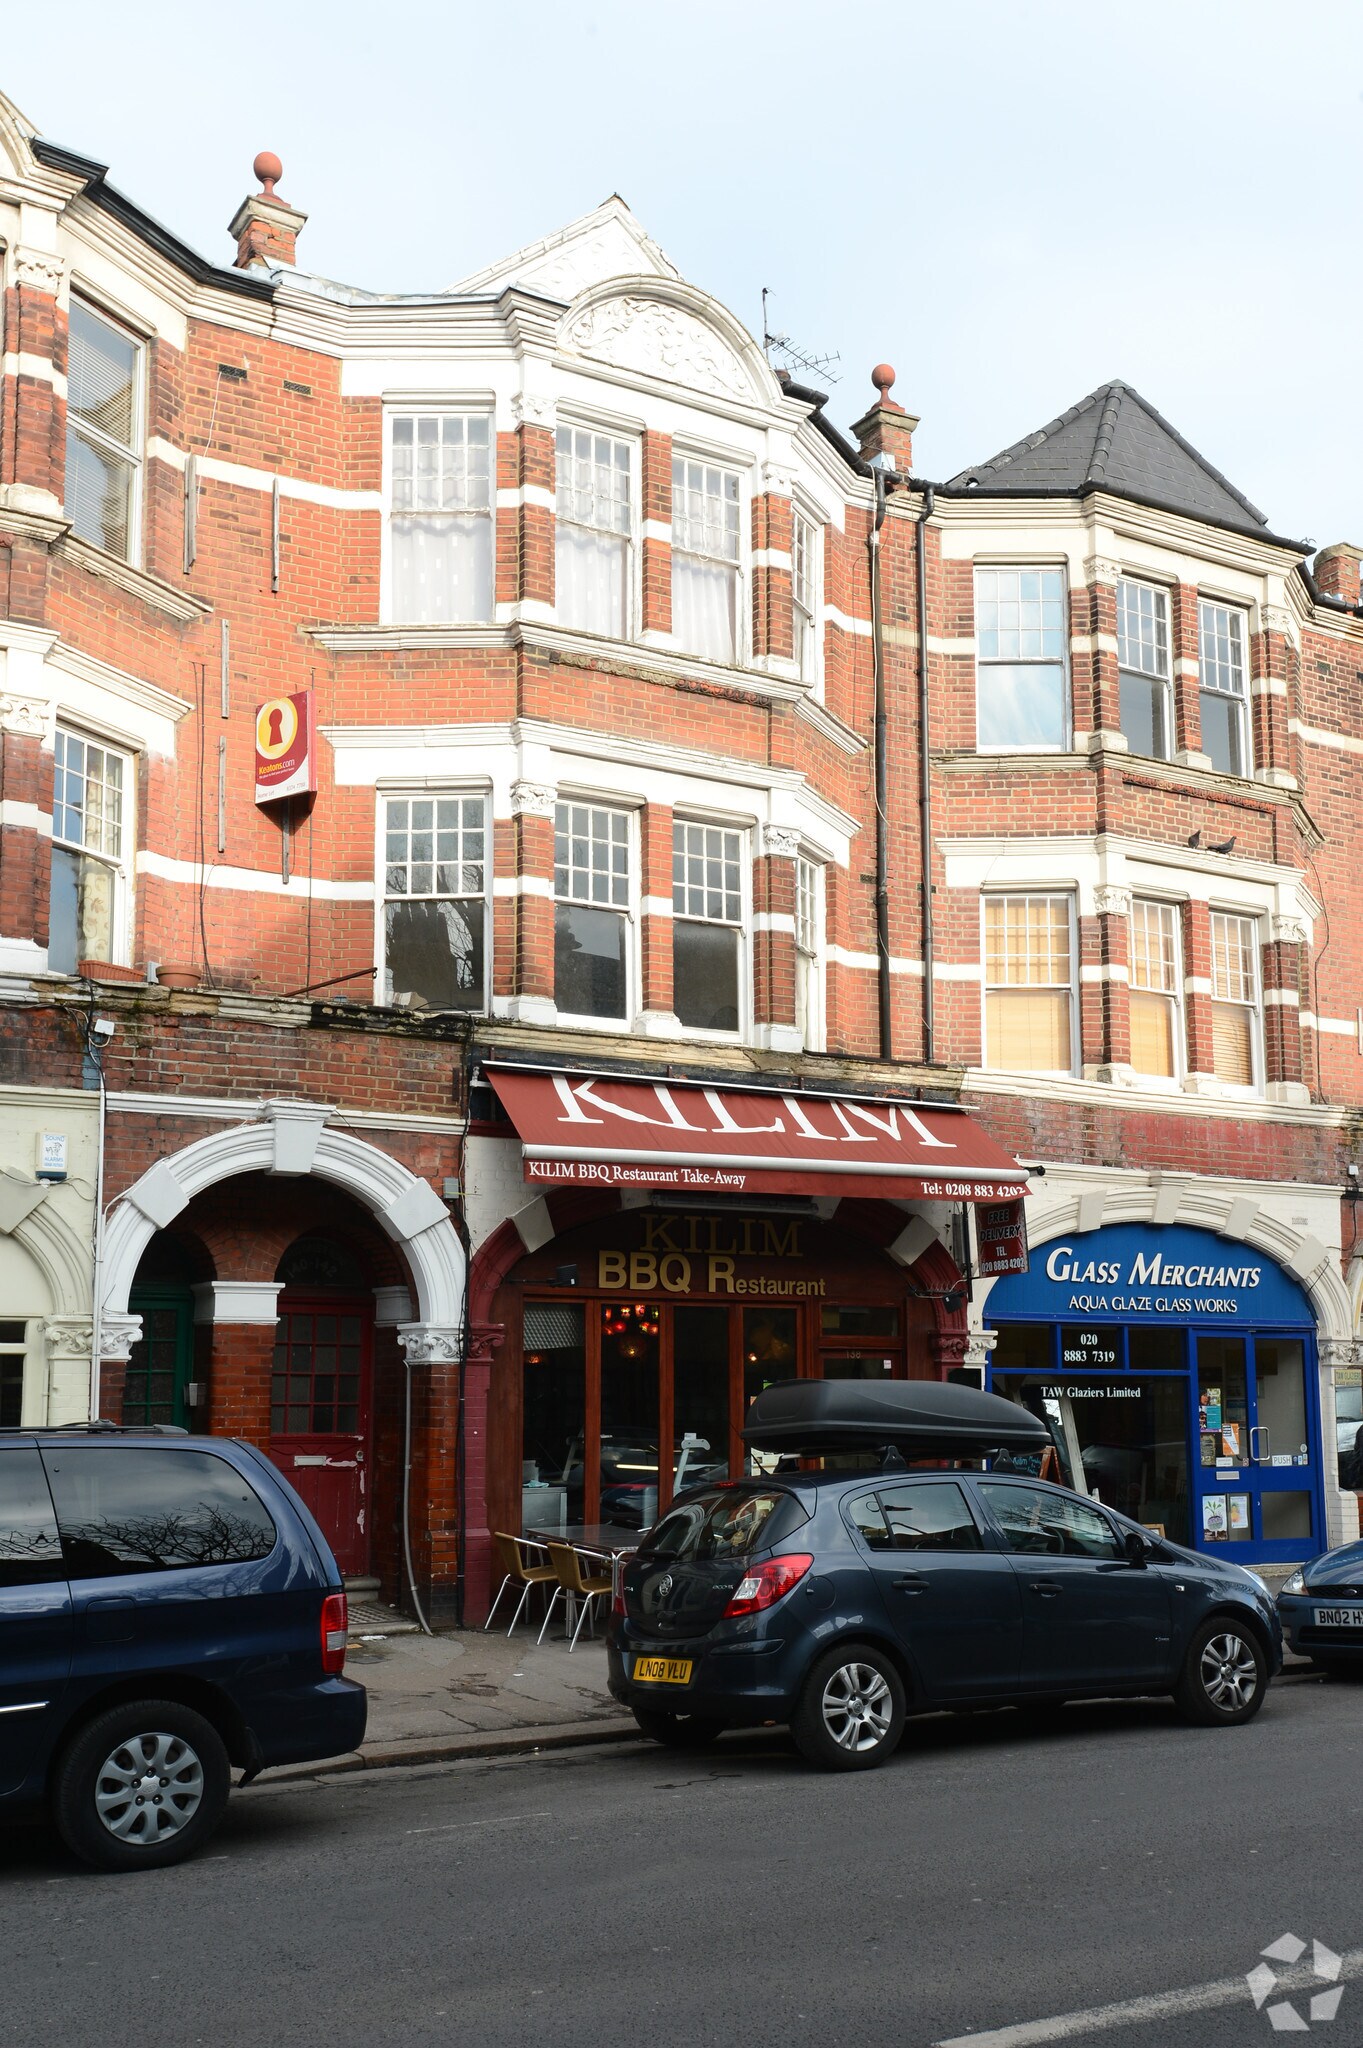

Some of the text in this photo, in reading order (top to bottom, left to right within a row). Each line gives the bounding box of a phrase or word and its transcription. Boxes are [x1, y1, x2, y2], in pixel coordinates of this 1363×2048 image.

[551, 1073, 957, 1147] KILIM
[528, 1161, 746, 1188] KILIM BBQ Restaurant Take-Away
[921, 1181, 1025, 1198] Tel: 0208 883 4202
[988, 1208, 1009, 1225] FREE
[639, 1213, 804, 1257] KILIM
[980, 1224, 1021, 1242] DELIVERY
[598, 1250, 826, 1296] BBQ Restaurant
[981, 1257, 1025, 1272] 020 8883 4202
[1045, 1247, 1262, 1288] GLASS MERCHANTS
[1069, 1295, 1238, 1313] AQUA GLAZE GLASS WORKS
[1080, 1333, 1098, 1345] 020
[846, 1350, 861, 1359] 138
[1064, 1350, 1115, 1362] 8883 7319
[1041, 1386, 1141, 1398] TAW Glaziers Limited
[1319, 1610, 1350, 1624] BN02
[639, 1660, 688, 1680] LN08 VLU
